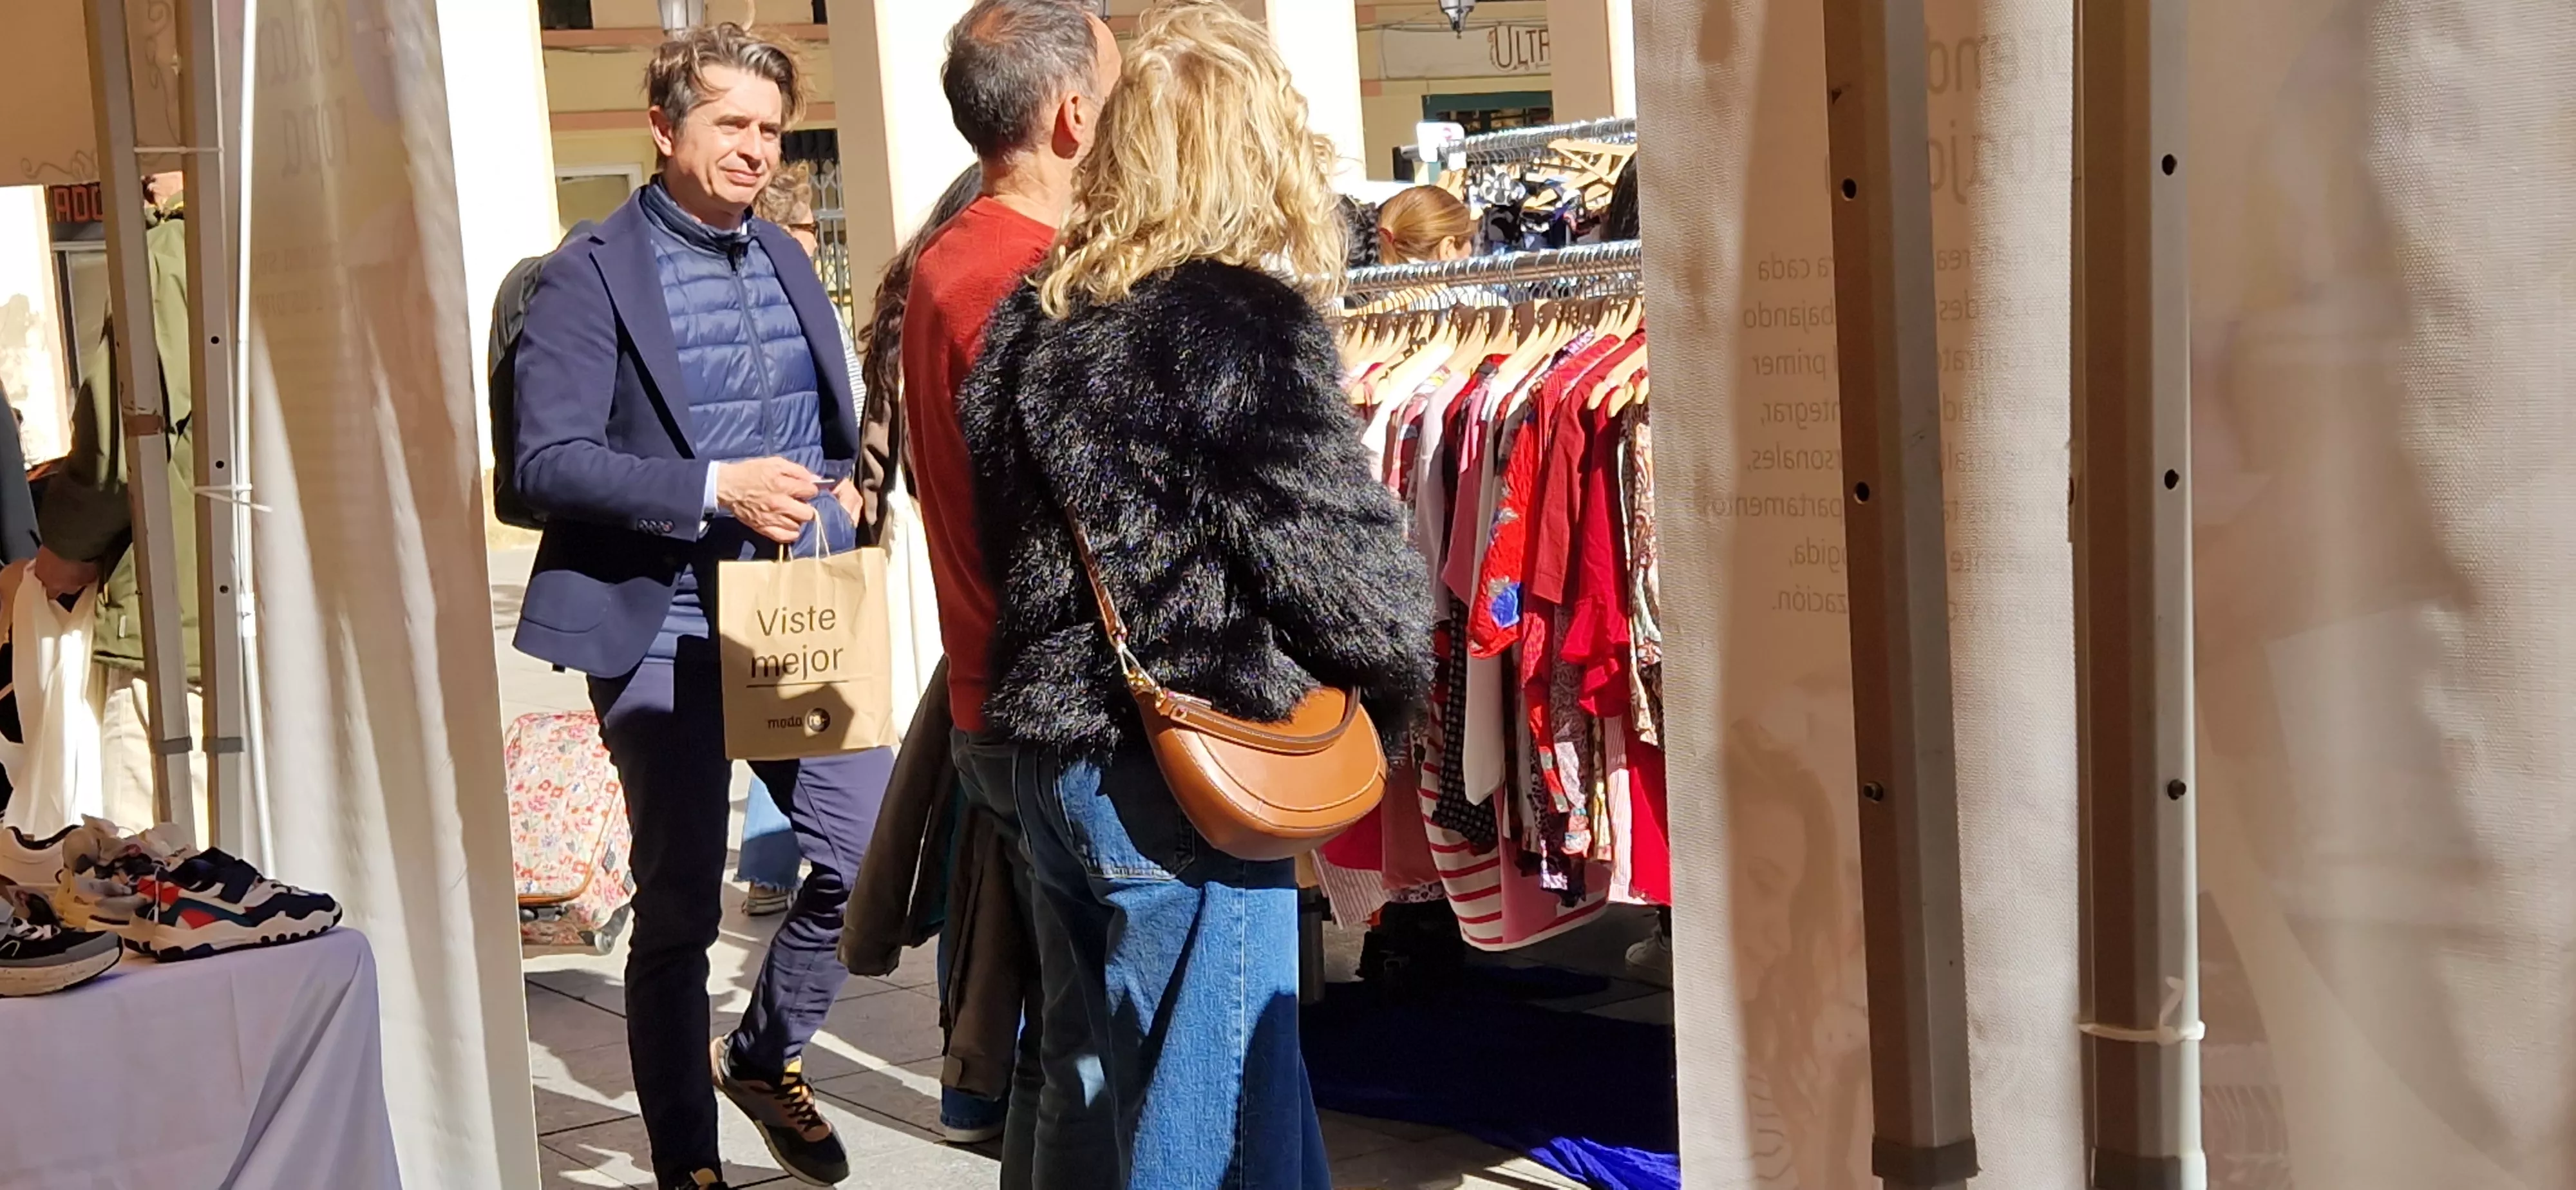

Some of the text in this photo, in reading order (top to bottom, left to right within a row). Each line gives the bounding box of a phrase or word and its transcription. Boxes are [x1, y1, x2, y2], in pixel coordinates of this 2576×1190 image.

[1493, 25, 1549, 68] ULTR
[757, 605, 837, 637] Viste
[751, 644, 844, 681] mejor
[767, 715, 803, 730] moda
